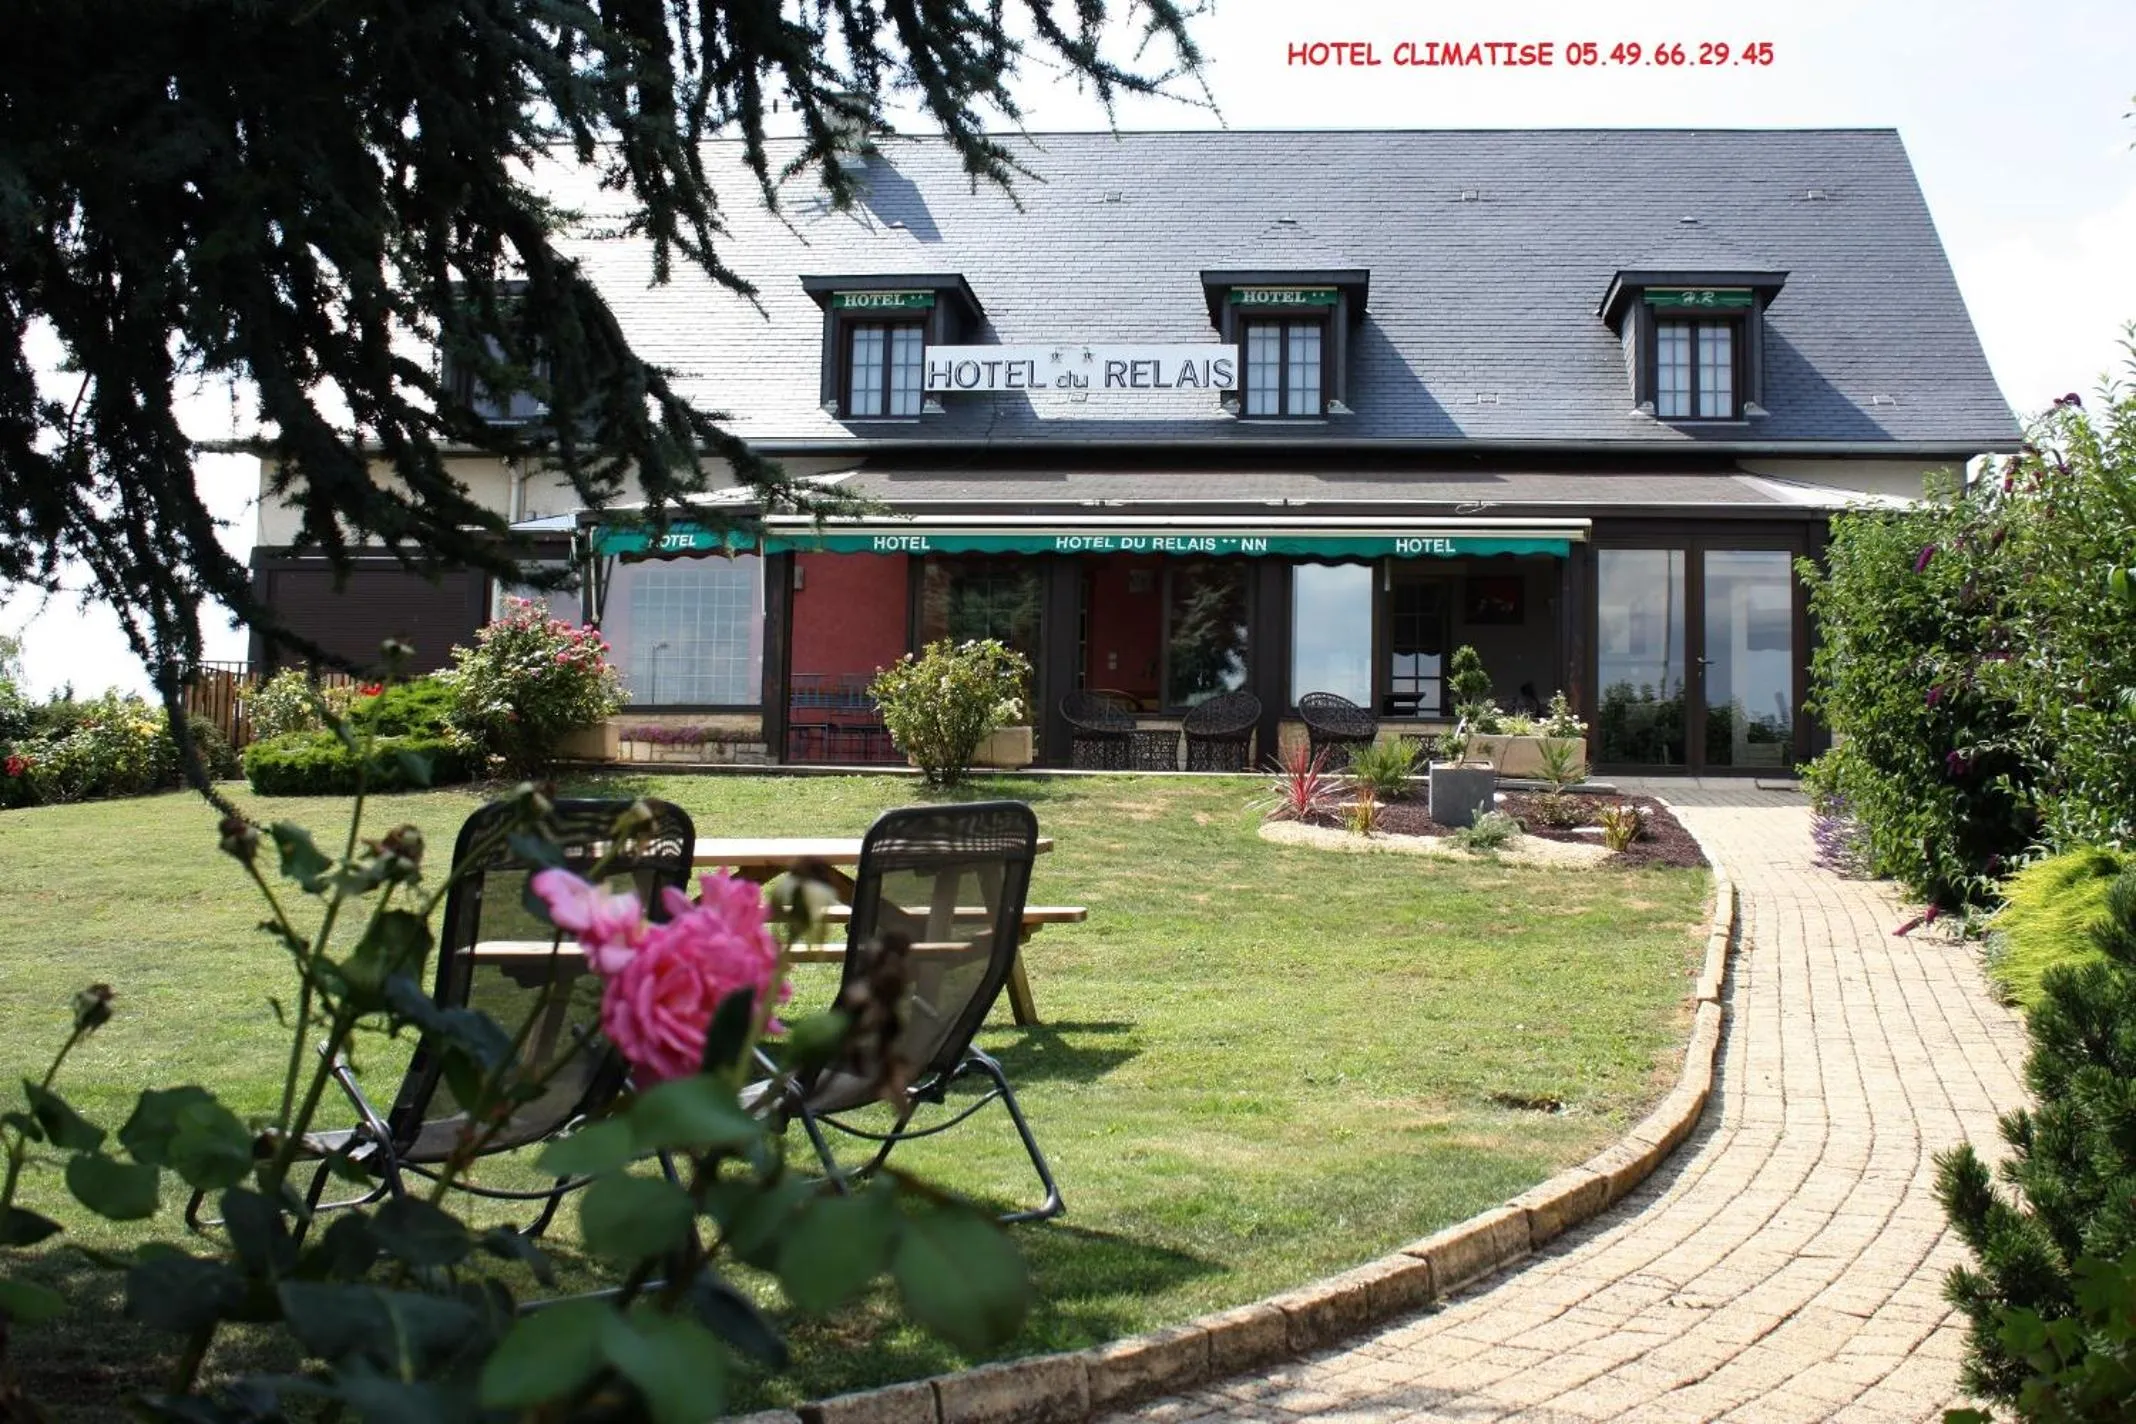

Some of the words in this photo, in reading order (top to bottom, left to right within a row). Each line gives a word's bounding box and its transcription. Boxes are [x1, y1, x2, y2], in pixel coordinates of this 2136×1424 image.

[843, 293, 905, 307] HOTEL
[1242, 290, 1306, 303] HOTEL
[928, 359, 1047, 389] HOTEL
[1055, 369, 1089, 388] du
[1104, 359, 1236, 388] RELAIS
[873, 536, 930, 550] HOTEL
[1055, 536, 1114, 549] HOTEL
[1120, 537, 1146, 550] DU
[1152, 537, 1216, 551] RELAIS
[1240, 538, 1267, 551] NN
[1395, 538, 1456, 552] HOTEL
